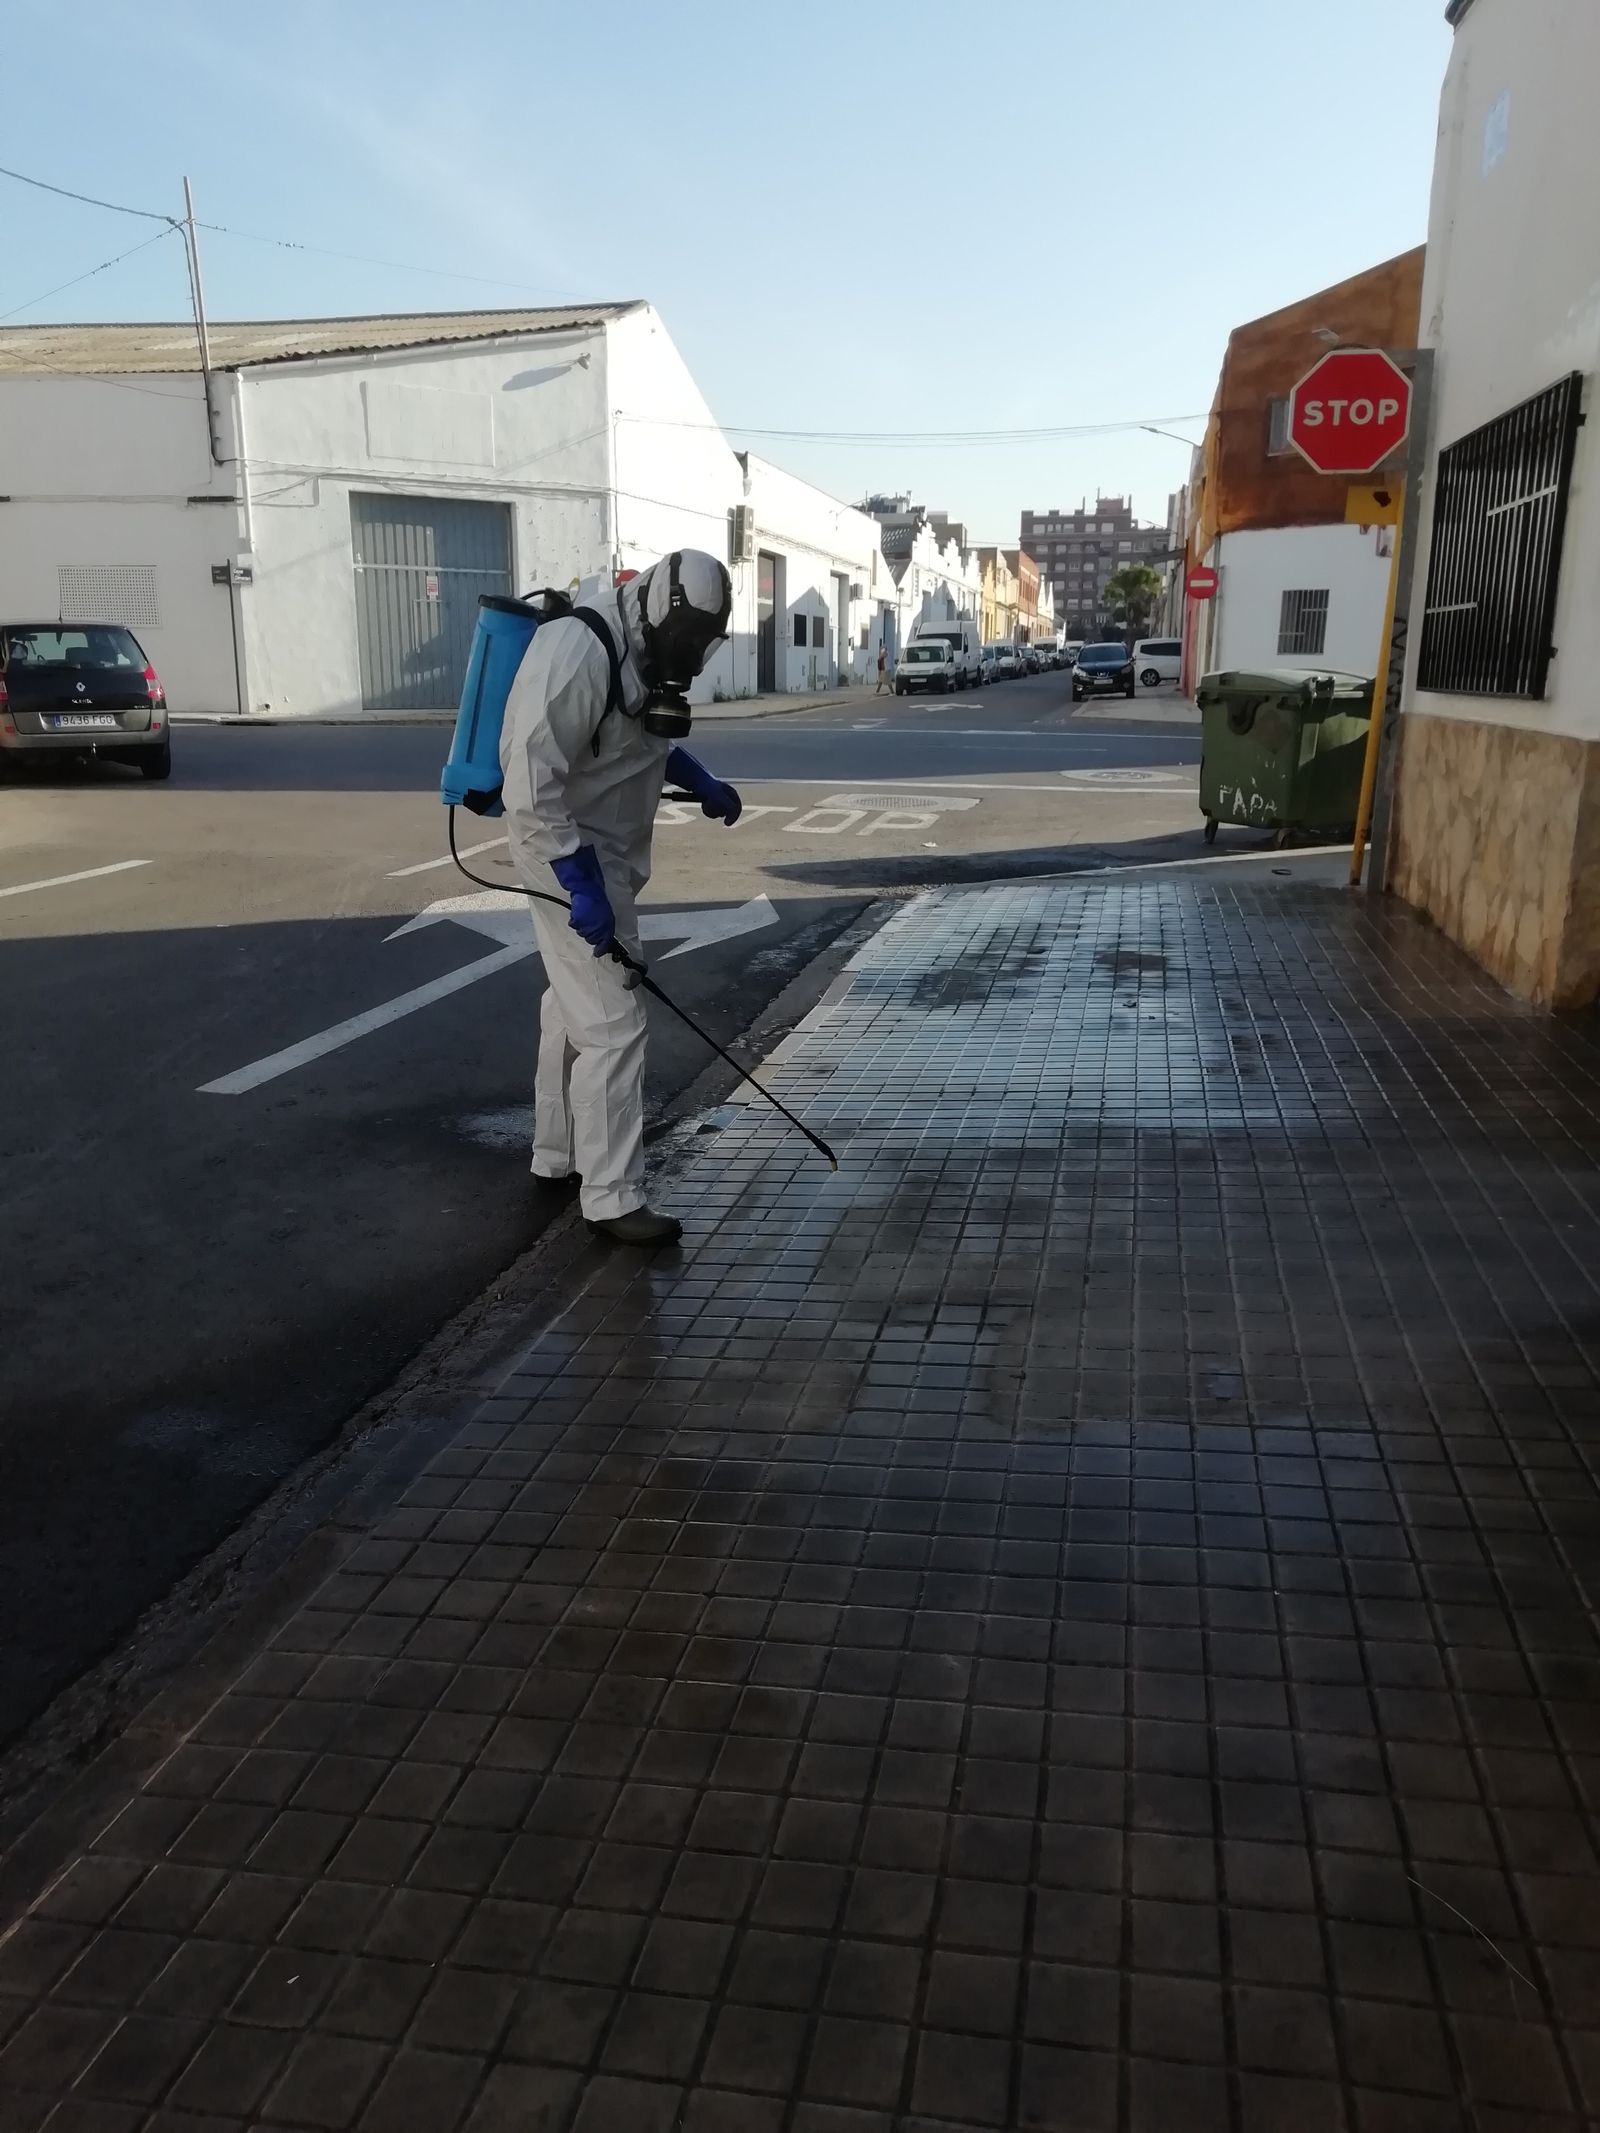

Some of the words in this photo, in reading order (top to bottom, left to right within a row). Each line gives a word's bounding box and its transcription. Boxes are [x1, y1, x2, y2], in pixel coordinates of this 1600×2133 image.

[1303, 398, 1399, 426] STOP
[62, 714, 90, 725] 9436
[653, 802, 940, 836] STOP
